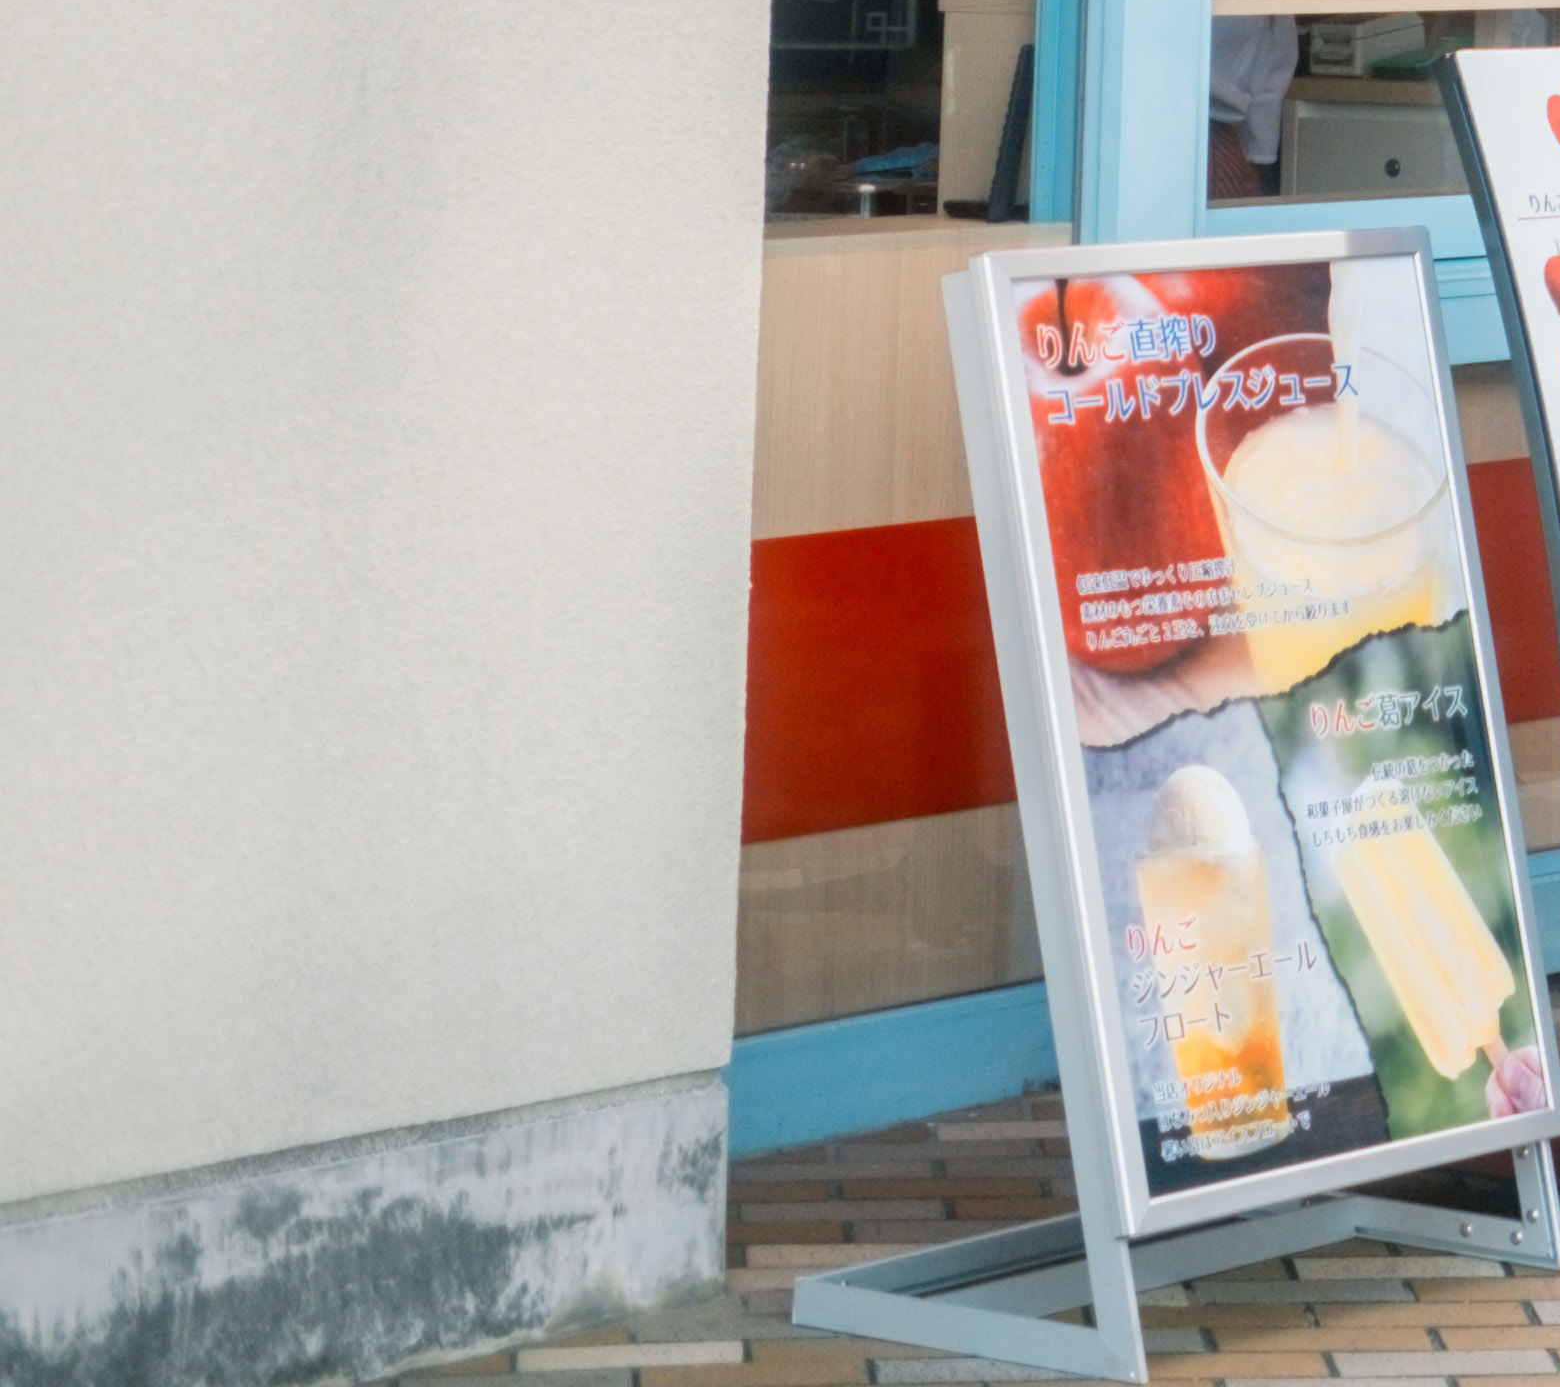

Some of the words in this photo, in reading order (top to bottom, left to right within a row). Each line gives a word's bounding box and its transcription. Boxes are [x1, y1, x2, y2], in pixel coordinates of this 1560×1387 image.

[1036, 313, 1218, 371] りんご直搾り
[1045, 363, 1360, 426] コールドプレスジュース
[1311, 684, 1468, 739] りんご葛アイス
[1125, 915, 1198, 963] りんご
[1131, 940, 1319, 1005] ジンジャーエール
[1138, 1001, 1233, 1049] フロート
